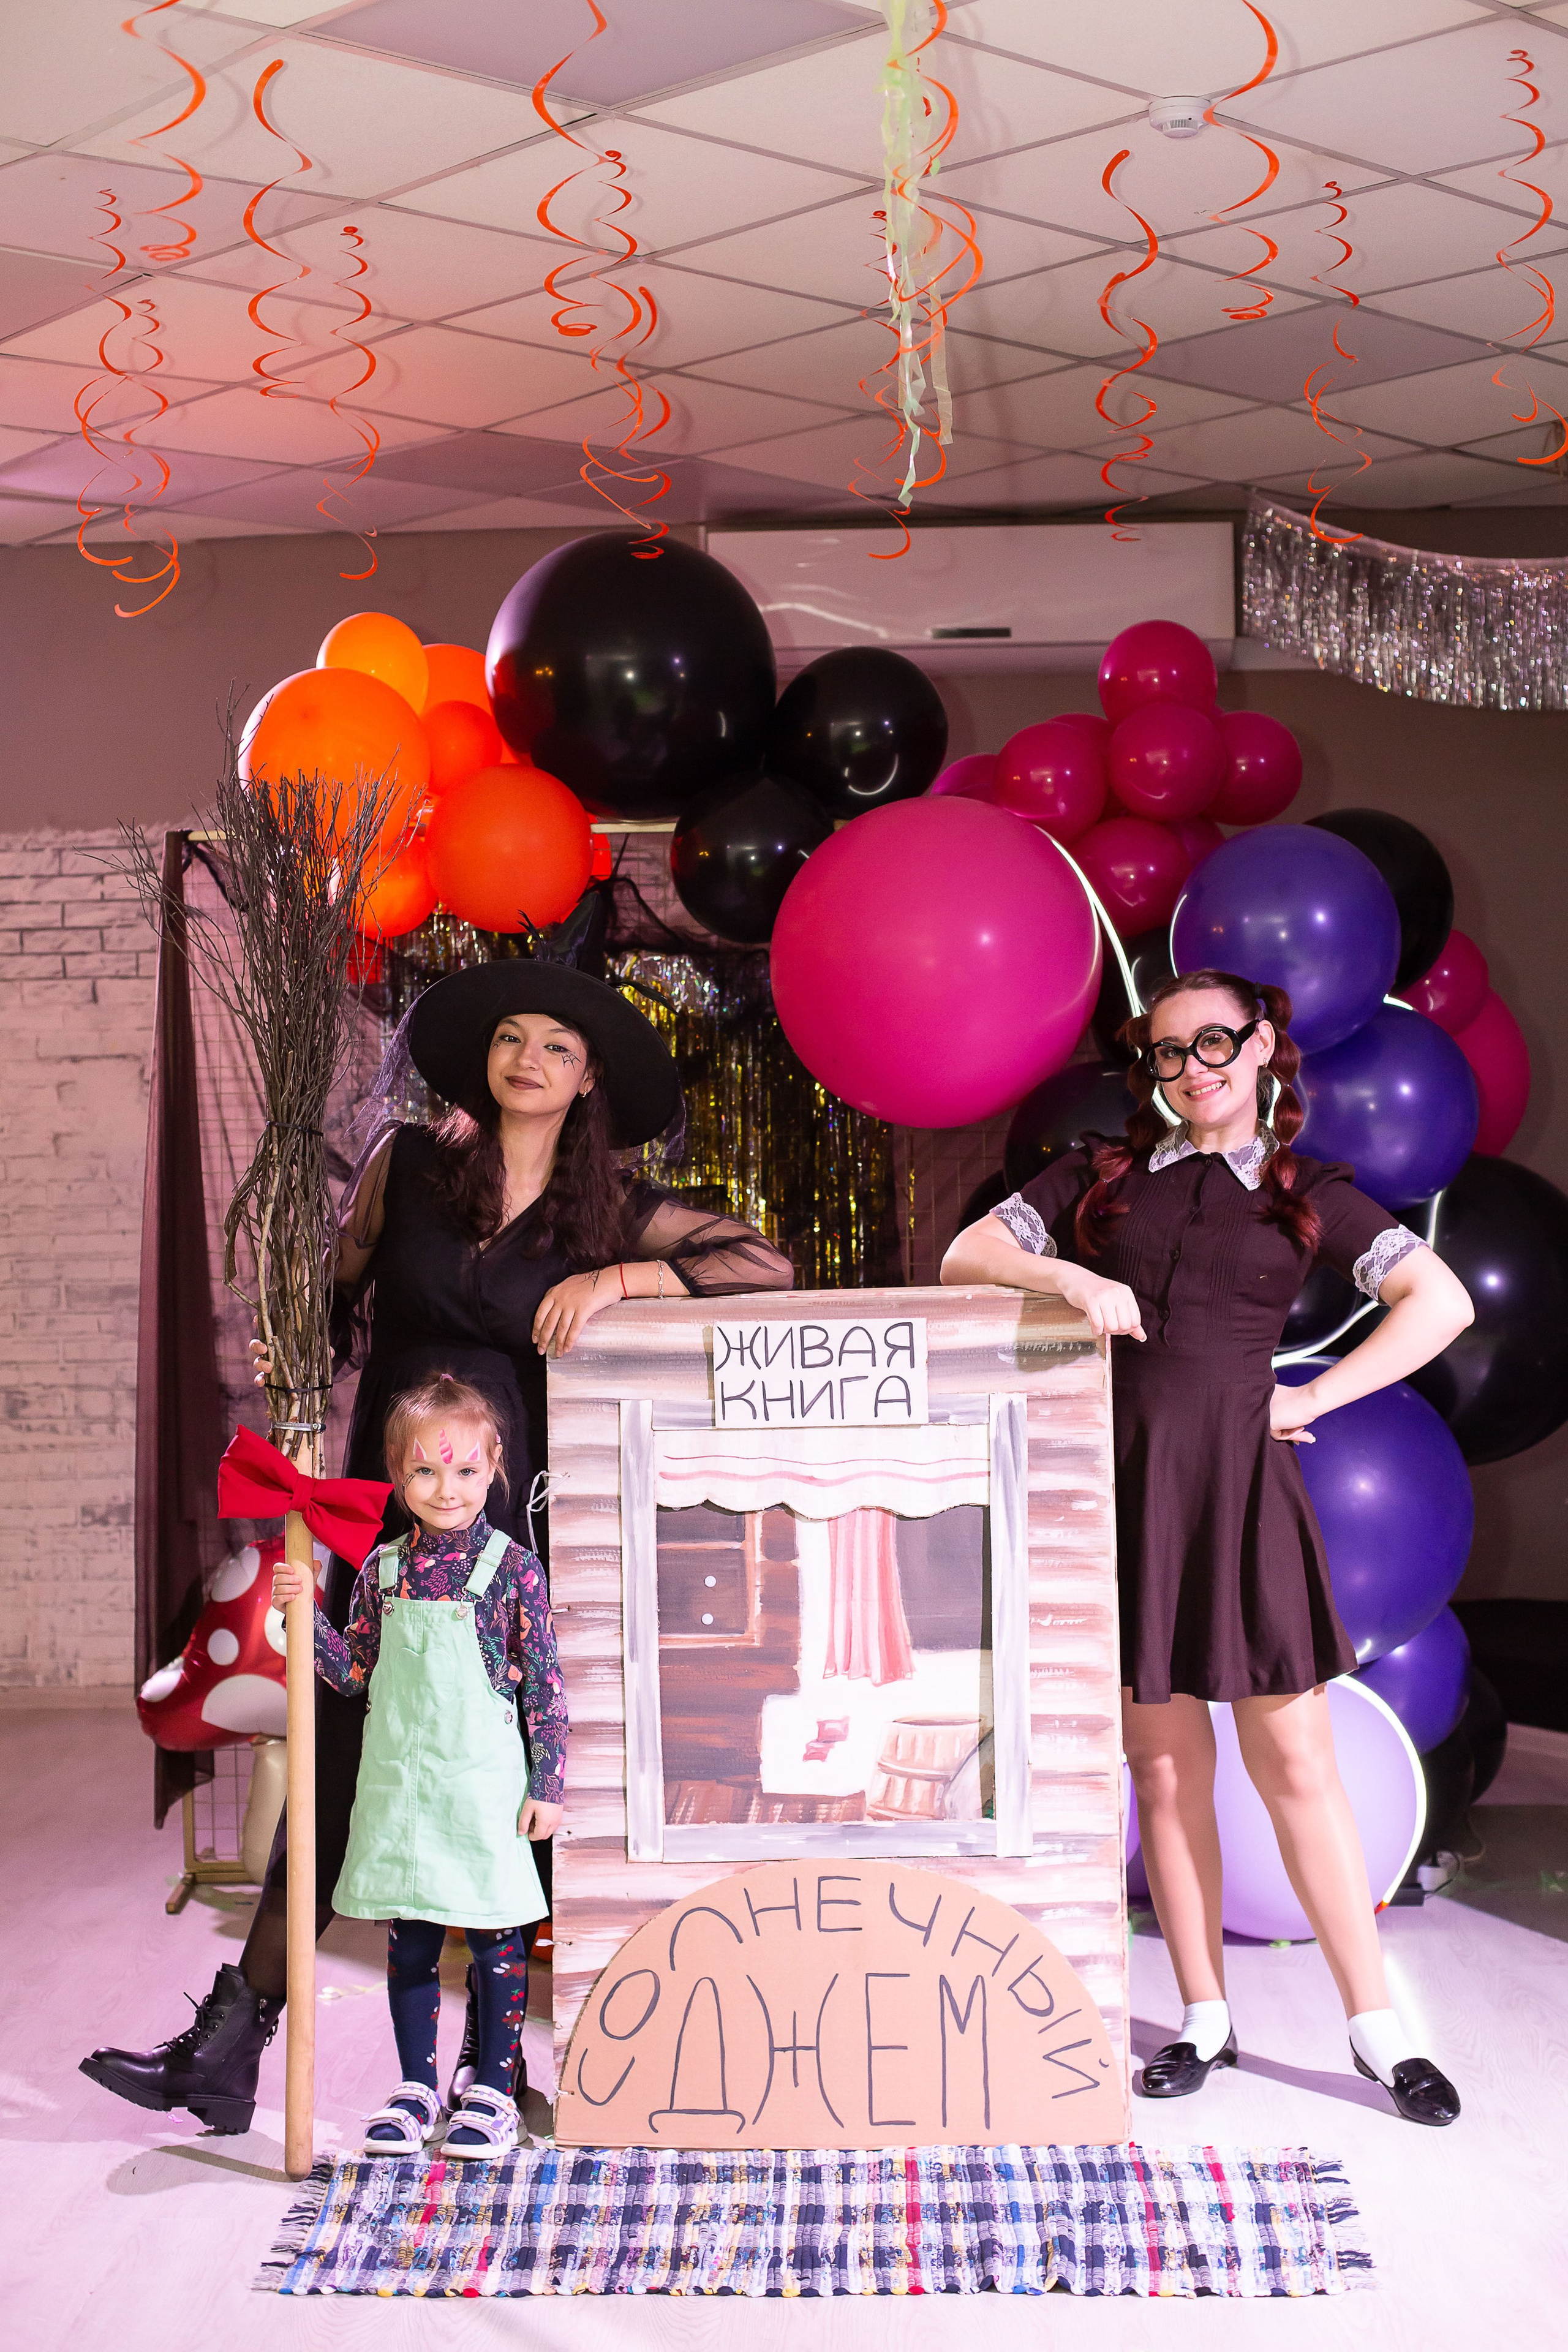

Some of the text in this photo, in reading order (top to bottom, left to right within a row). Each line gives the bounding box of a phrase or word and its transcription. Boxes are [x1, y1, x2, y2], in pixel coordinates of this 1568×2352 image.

[715, 1322, 914, 1371] ЖИВАЯ
[721, 1376, 911, 1421] КНИГА
[578, 1875, 1110, 2106] СОЛНЕЧНЫЙ
[649, 1973, 990, 2134] ДЖЕМ
